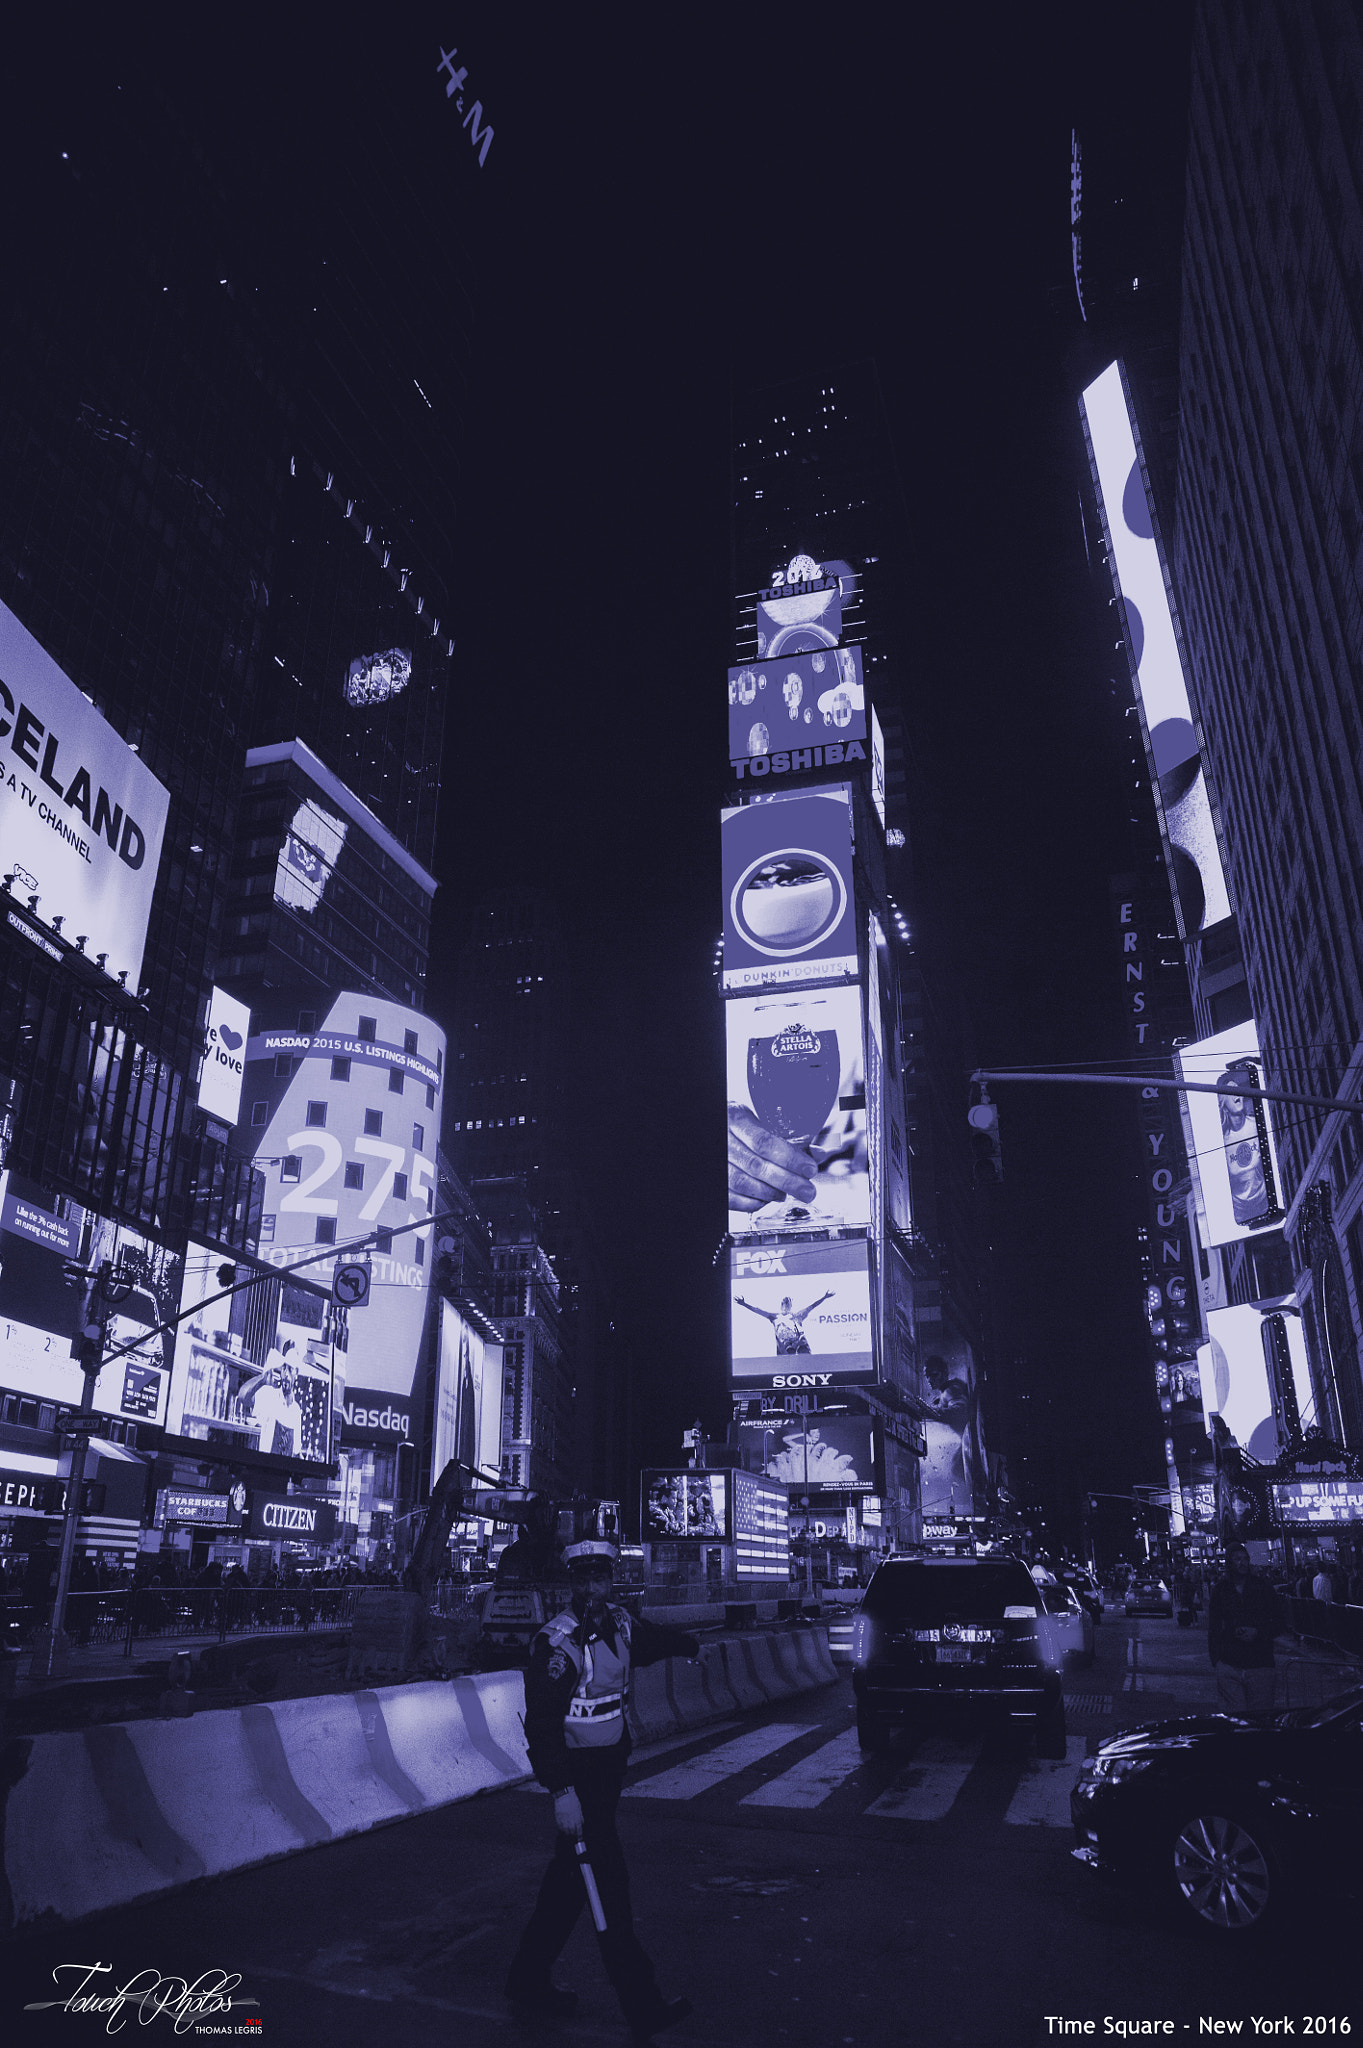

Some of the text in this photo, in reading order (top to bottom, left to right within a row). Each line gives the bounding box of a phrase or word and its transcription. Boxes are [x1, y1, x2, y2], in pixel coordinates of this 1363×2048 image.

[758, 577, 838, 600] TOSHIBA
[730, 741, 867, 779] TOSHIBA
[7, 773, 16, 792] A
[20, 781, 37, 808] TV
[38, 802, 92, 865] CHANNEL
[14, 863, 39, 891] VICE
[794, 962, 843, 977] DONUTS
[1120, 903, 1150, 1045] ERNST
[779, 1034, 813, 1045] STELLA
[779, 1041, 814, 1051] ARTOIS
[216, 1045, 243, 1075] love
[265, 1037, 440, 1085] NASDAQ 2015 U.S. LISTINGS HIGHLIGHTS
[280, 1130, 435, 1239] 275
[16, 1204, 29, 1218] Like
[29, 1211, 38, 1222] the
[46, 1221, 58, 1232] cash
[58, 1224, 69, 1237] back
[1148, 1133, 1187, 1301] YOUNG
[14, 1218, 22, 1226] on
[22, 1221, 41, 1237] running
[40, 1229, 50, 1239] out
[57, 1237, 70, 1248] more
[736, 1249, 788, 1276] FOX
[819, 1312, 868, 1324] PASSION
[772, 1373, 833, 1388] SONY
[341, 1402, 410, 1440] Nasdaq
[1295, 1460, 1347, 1475] Hard Rock
[168, 1497, 228, 1508] STARBUCKS
[1295, 1495, 1313, 1508] UP
[1313, 1494, 1347, 1508] SOME
[262, 1502, 318, 1532] CITIZEN
[848, 1508, 856, 1542] NYPD
[569, 1704, 597, 1718] NY
